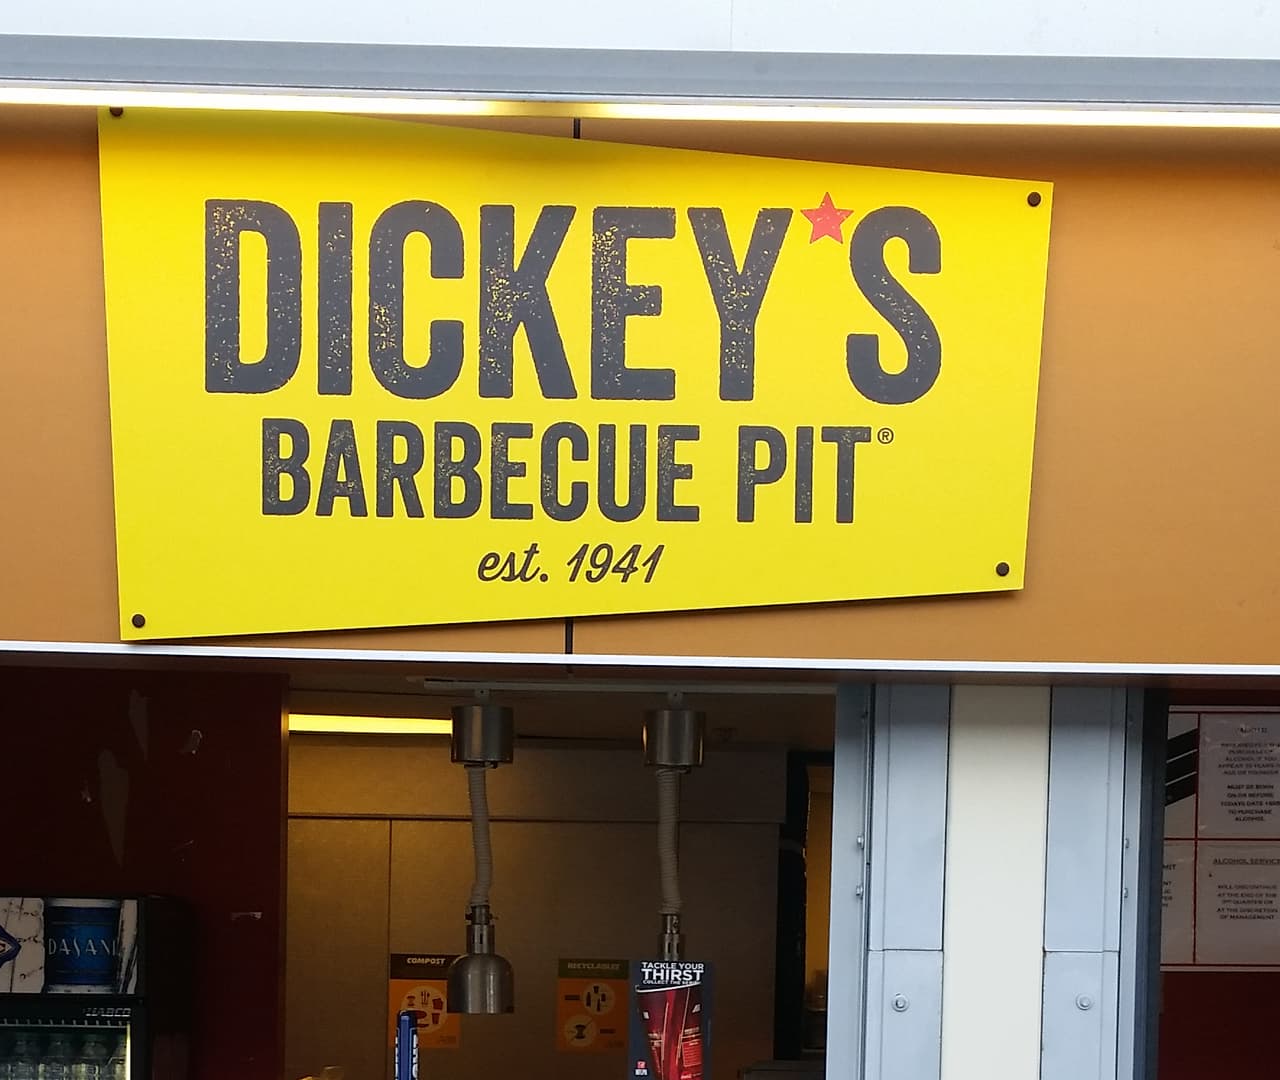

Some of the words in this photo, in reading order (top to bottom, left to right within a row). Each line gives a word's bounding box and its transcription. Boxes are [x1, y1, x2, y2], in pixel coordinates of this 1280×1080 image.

[205, 192, 942, 405] DICKEY'S
[261, 418, 700, 524] BARBECUE
[477, 545, 549, 583] est.
[566, 543, 665, 585] 1941
[406, 957, 446, 965] COMPOST
[642, 962, 677, 970] TACKLE
[641, 969, 704, 981] THIRST
